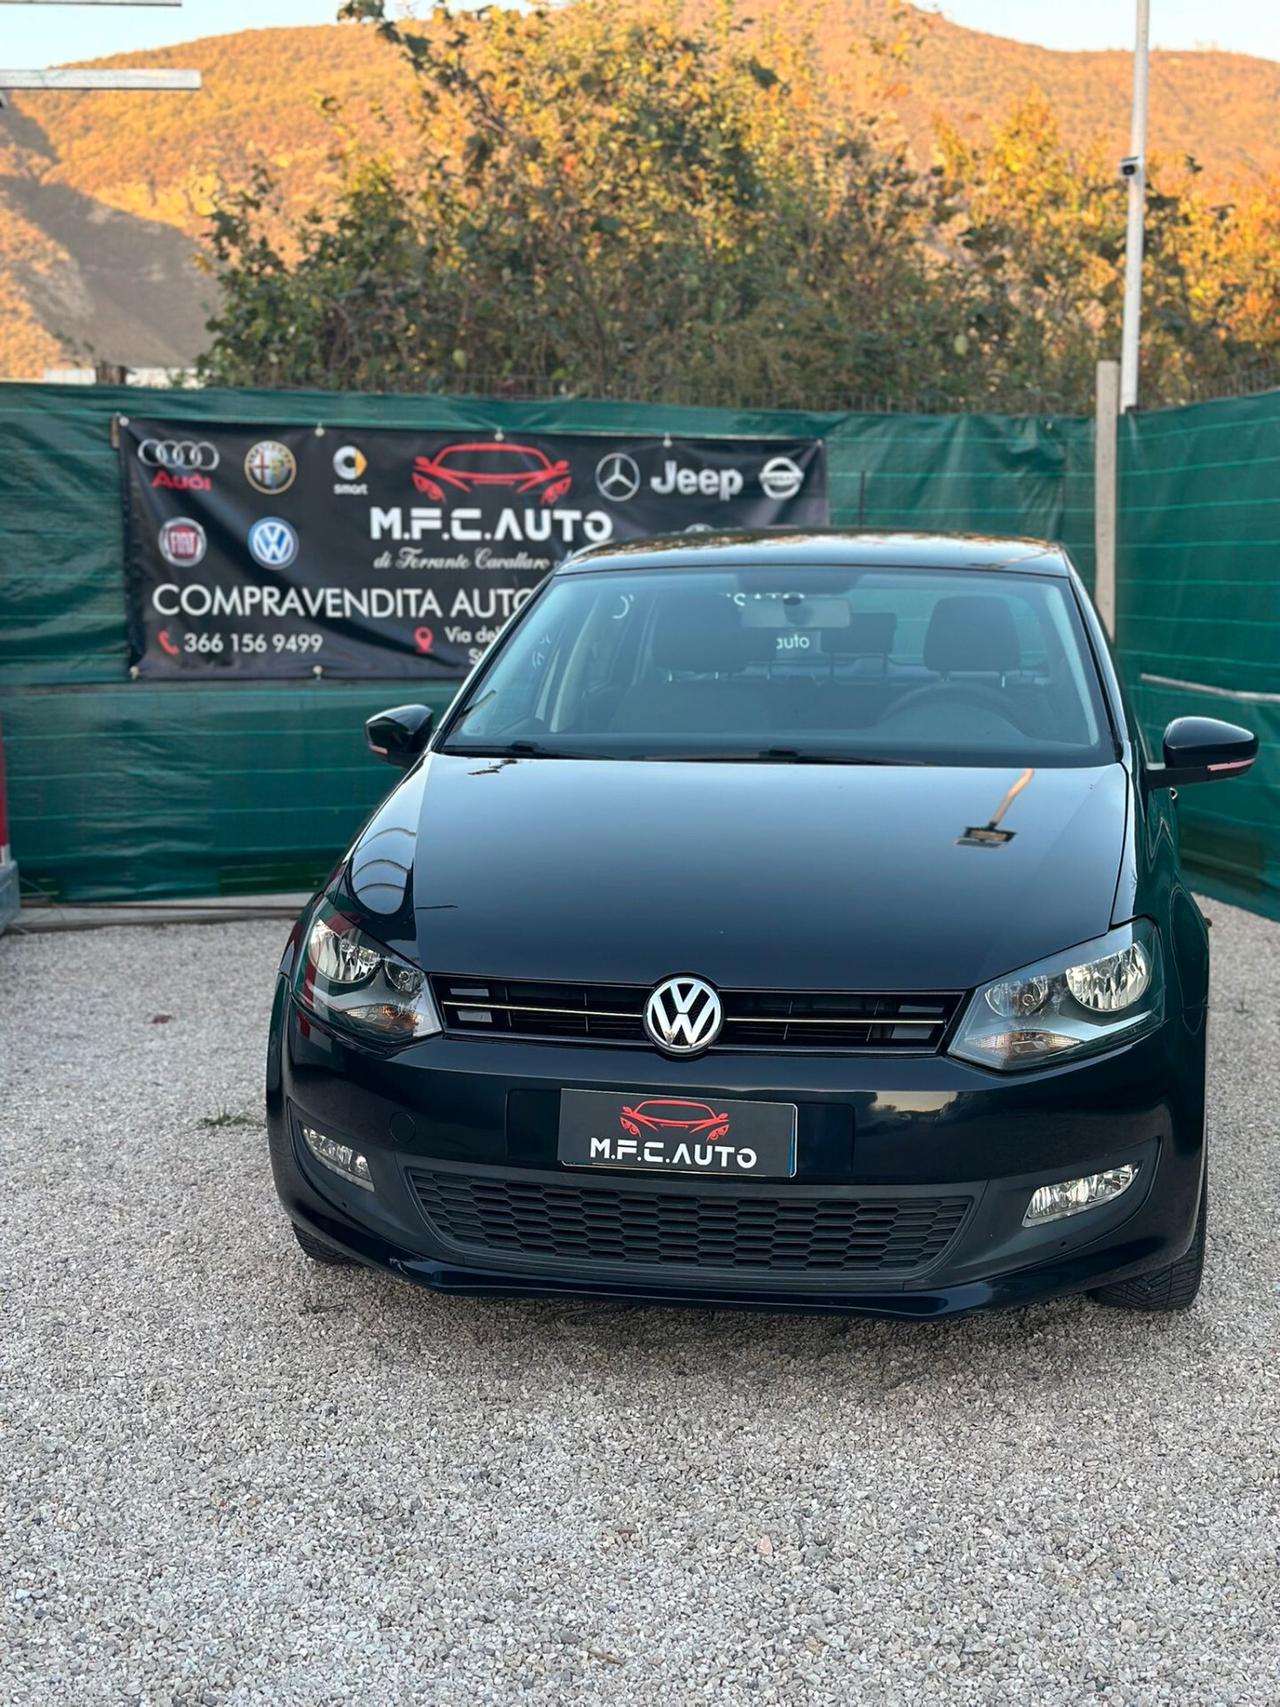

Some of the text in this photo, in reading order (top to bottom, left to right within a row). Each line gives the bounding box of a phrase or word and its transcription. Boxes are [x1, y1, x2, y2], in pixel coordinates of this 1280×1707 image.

[151, 470, 212, 491] Audi
[333, 484, 369, 496] smart
[651, 461, 743, 500] Jeep
[370, 507, 612, 542] M.F.C.AUTO
[373, 552, 391, 569] di
[395, 546, 471, 569] Ferrante
[152, 583, 442, 618] COMPRAVENDITA
[184, 633, 323, 653] 366 156 9499
[444, 626, 472, 643] Via
[590, 1137, 757, 1169] M.F.C.AUTO
